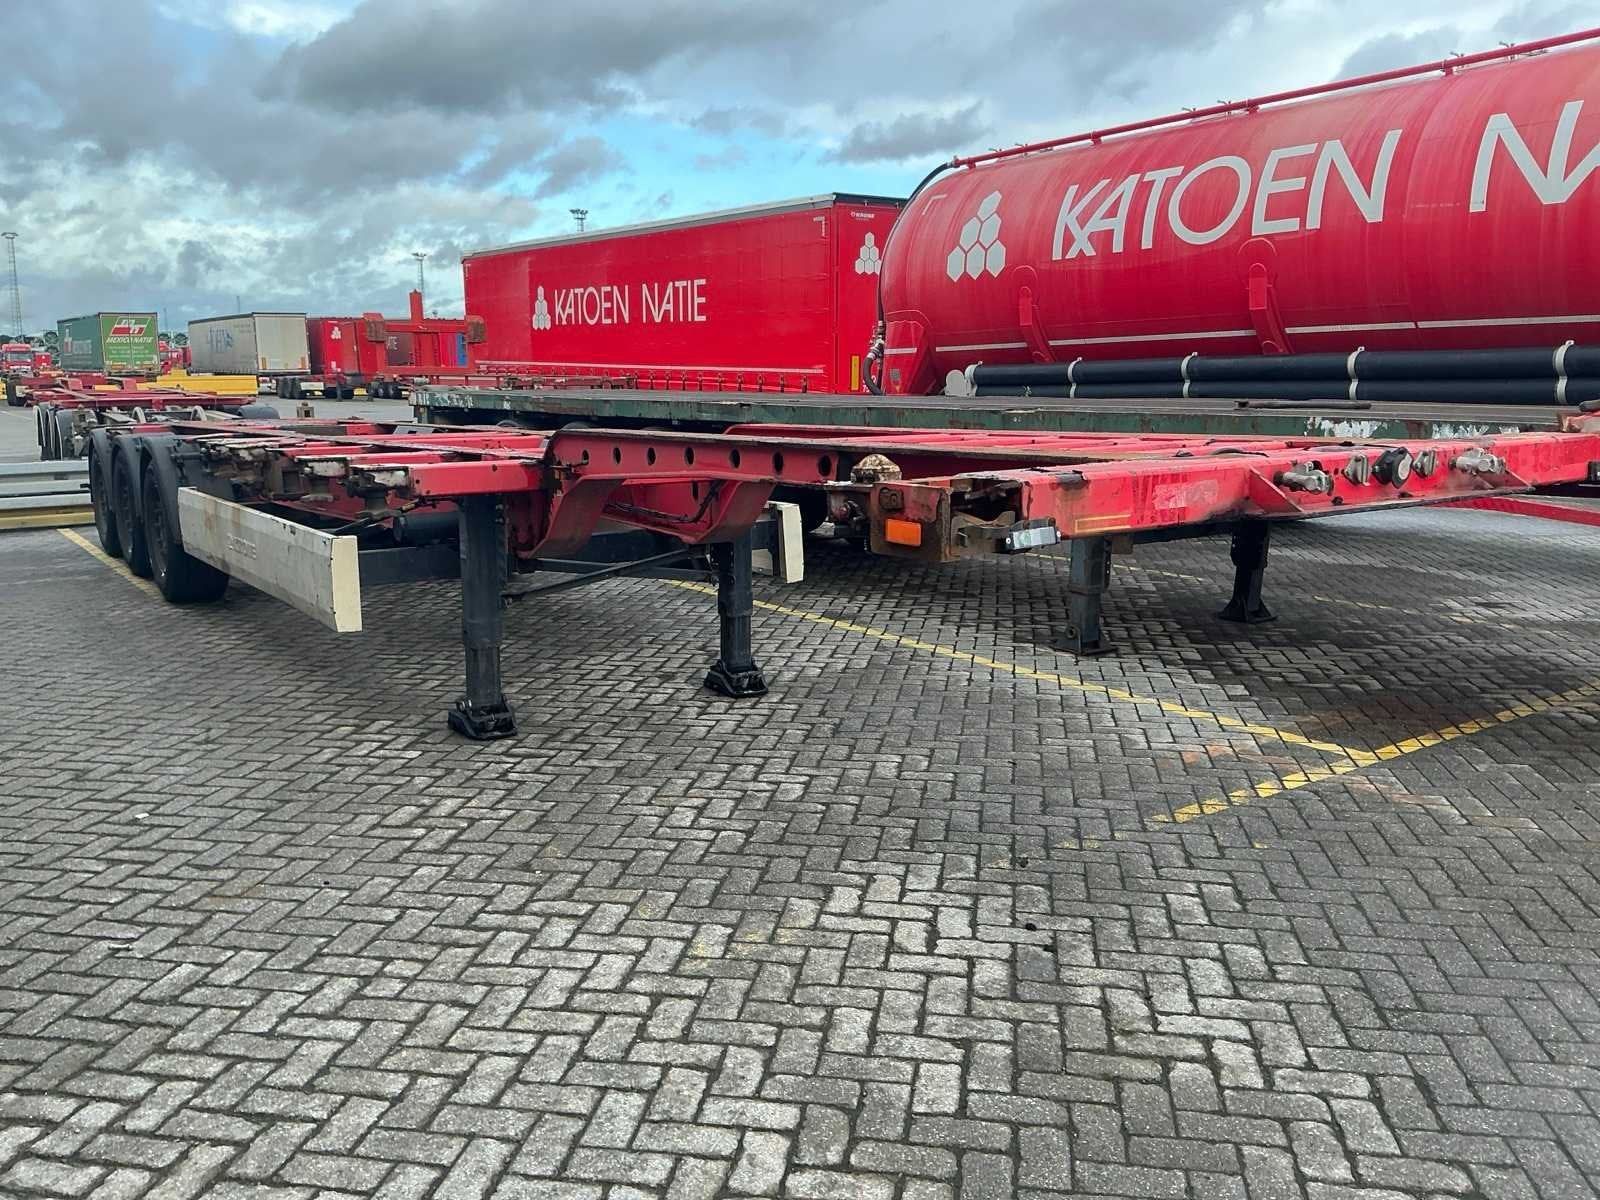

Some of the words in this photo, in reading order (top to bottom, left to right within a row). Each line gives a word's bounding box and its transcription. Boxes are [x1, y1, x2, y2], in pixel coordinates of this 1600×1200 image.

[1052, 129, 1402, 260] KATOEN
[554, 284, 629, 325] KATOEN
[642, 279, 706, 323] NATIE
